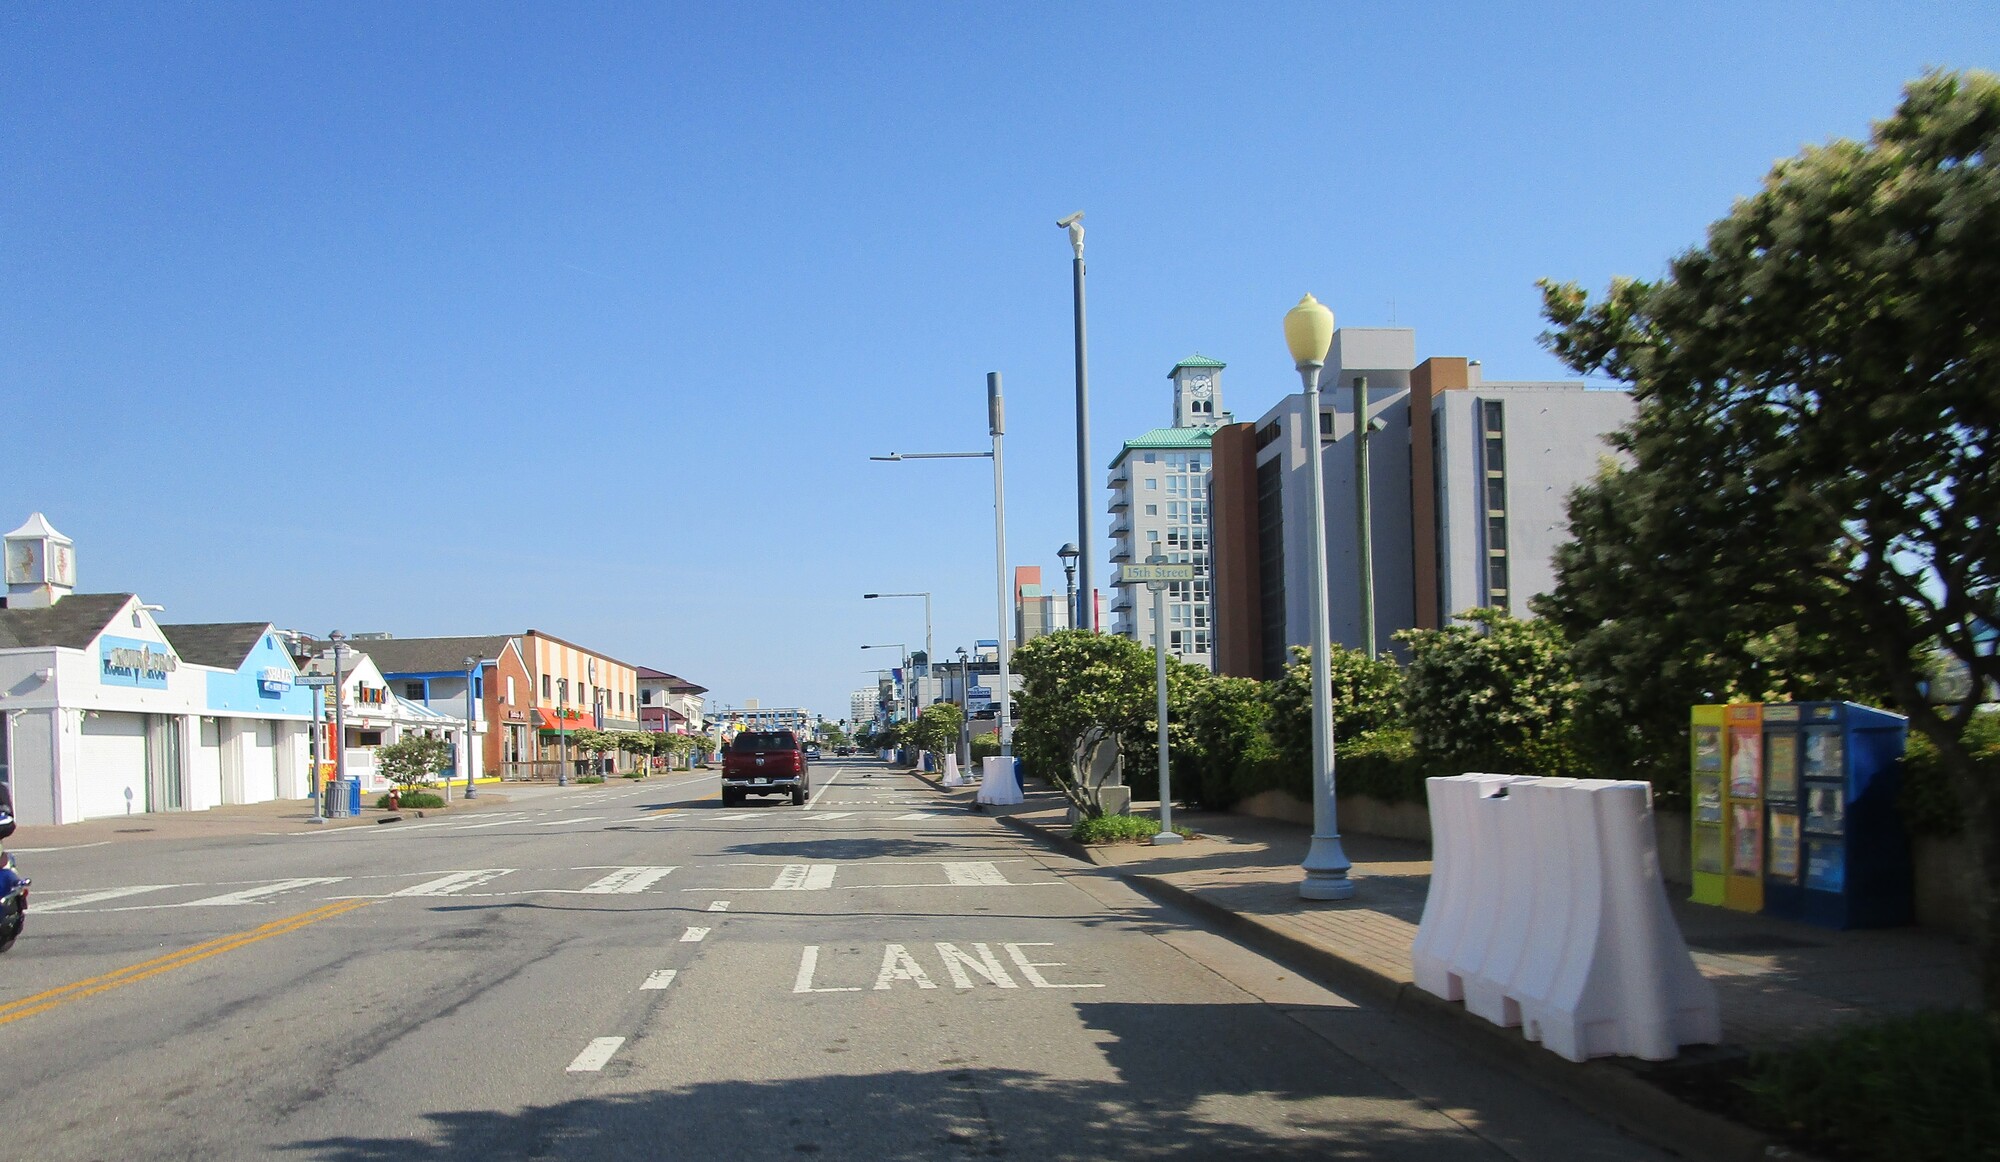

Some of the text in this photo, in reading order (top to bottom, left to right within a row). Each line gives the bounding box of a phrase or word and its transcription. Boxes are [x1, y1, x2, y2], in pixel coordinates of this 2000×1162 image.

[1127, 567, 1188, 578] 15th Street
[792, 942, 1106, 993] LANE
